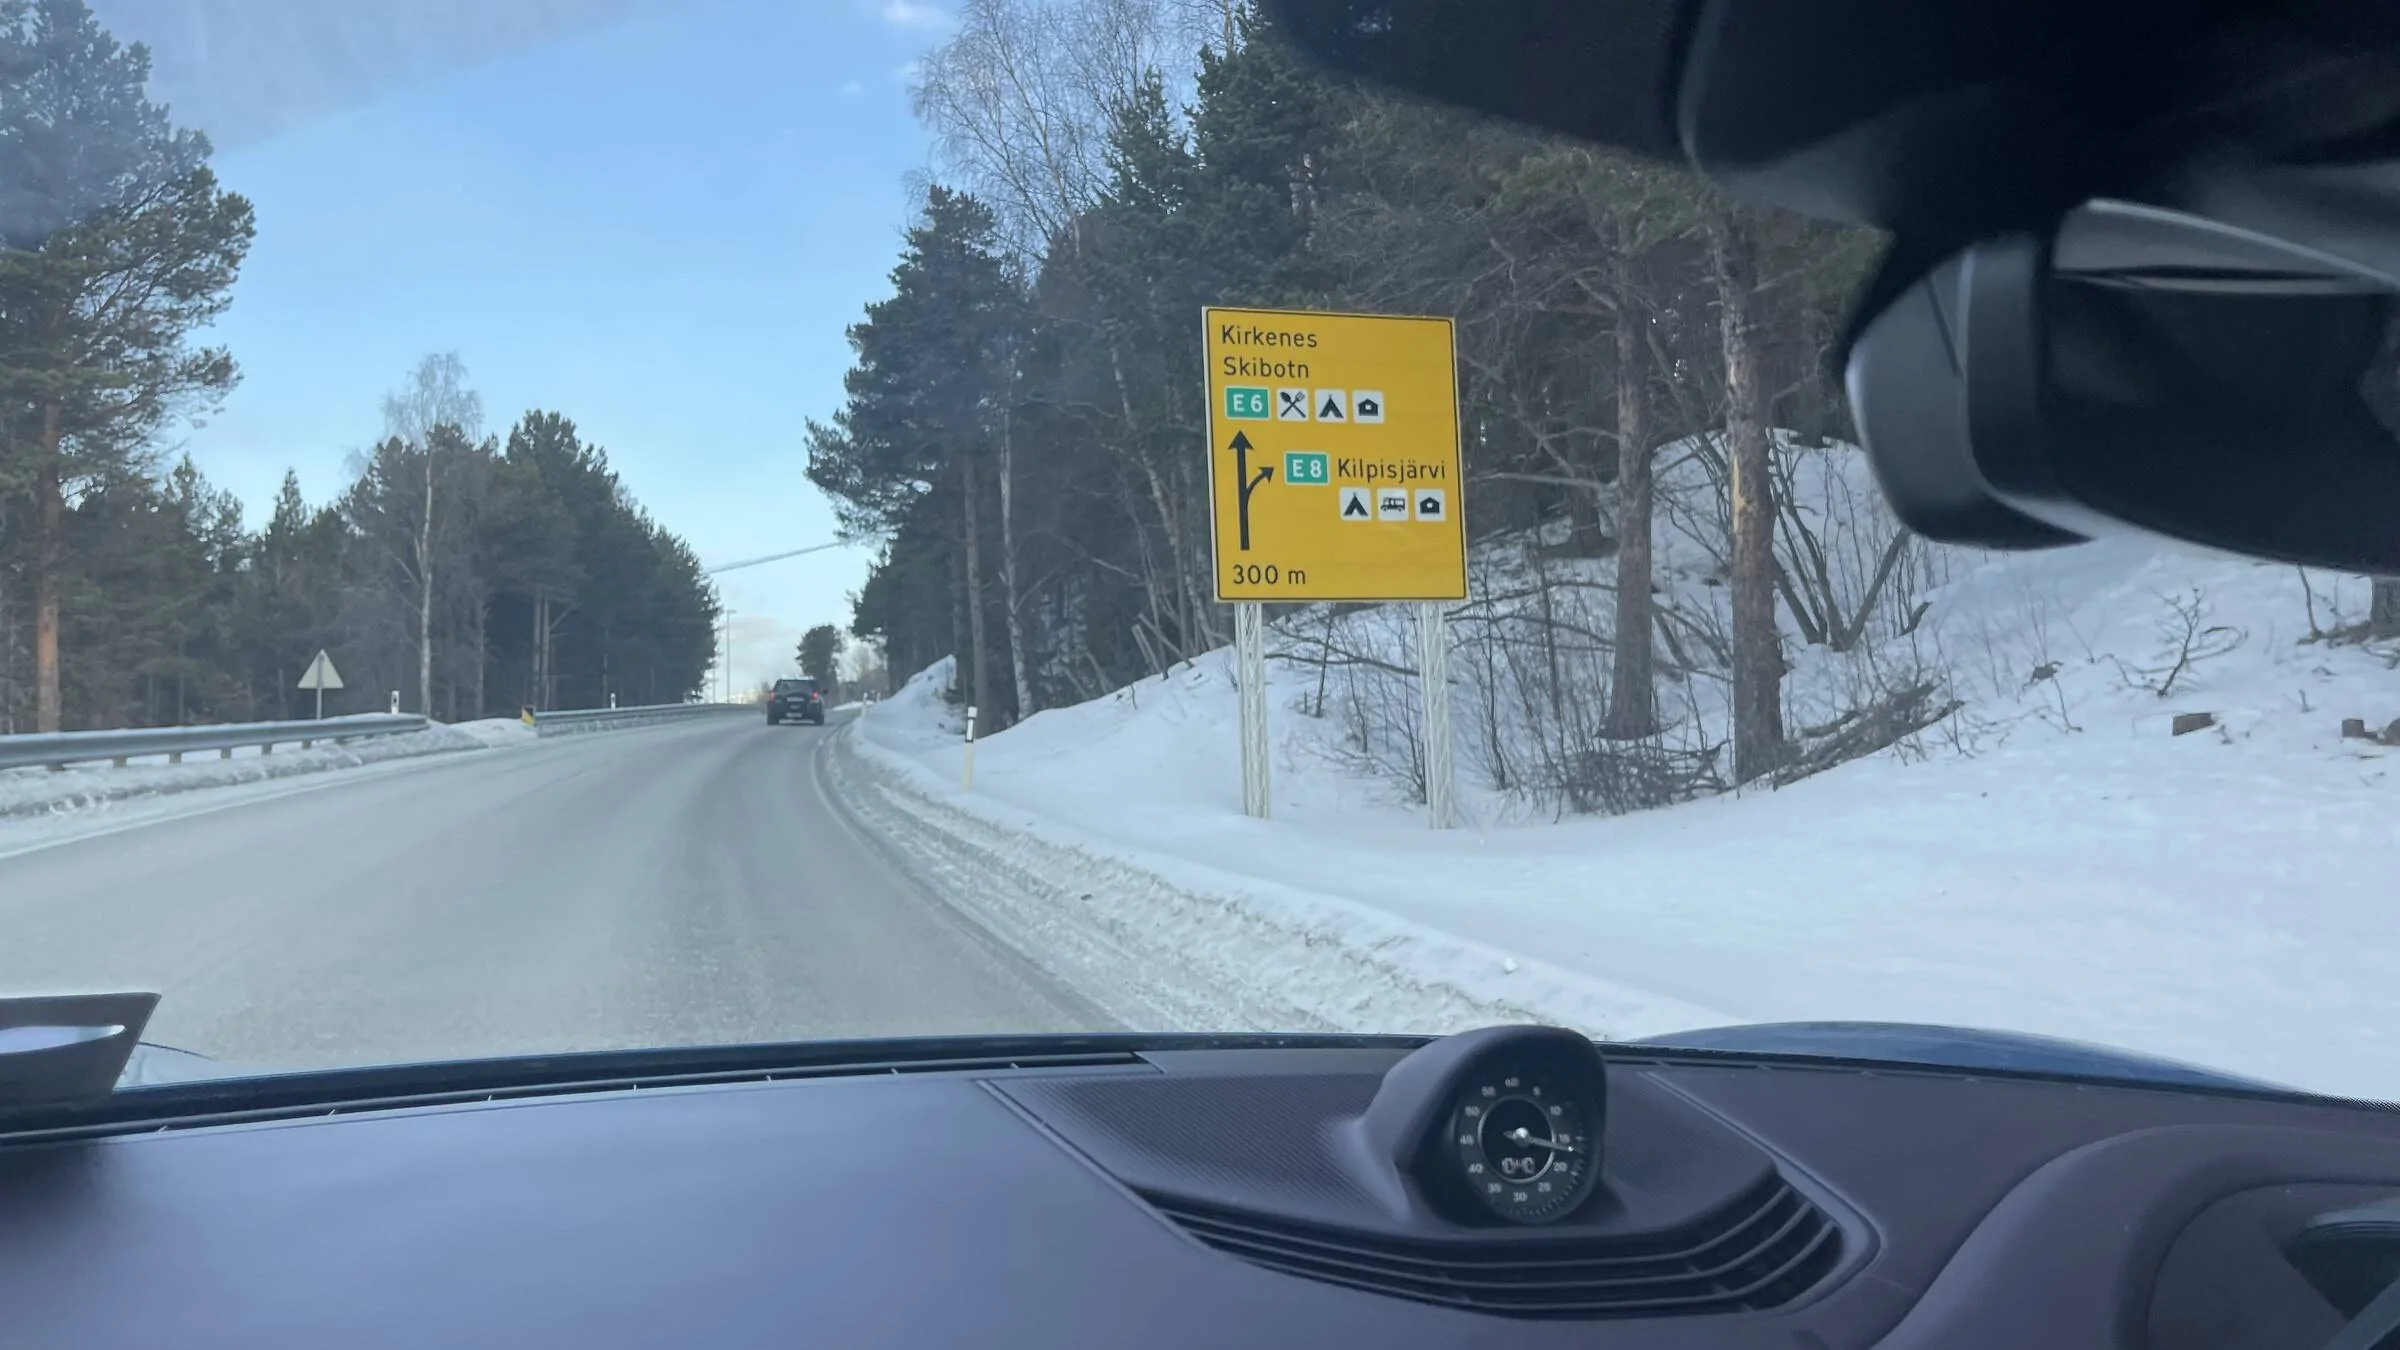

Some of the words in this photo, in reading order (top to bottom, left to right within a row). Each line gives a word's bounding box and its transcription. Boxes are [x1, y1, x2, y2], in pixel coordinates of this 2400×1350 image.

[1222, 325, 1318, 348] Kirkenes
[1223, 356, 1310, 379] Skibotn
[1337, 458, 1446, 483] Kilpisjärvi
[1233, 565, 1279, 586] 300
[1288, 569, 1307, 585] m
[1550, 1105, 1564, 1116] 10
[1469, 1163, 1484, 1174] 40
[1552, 1162, 1568, 1172] 20
[1512, 1191, 1528, 1203] 30
